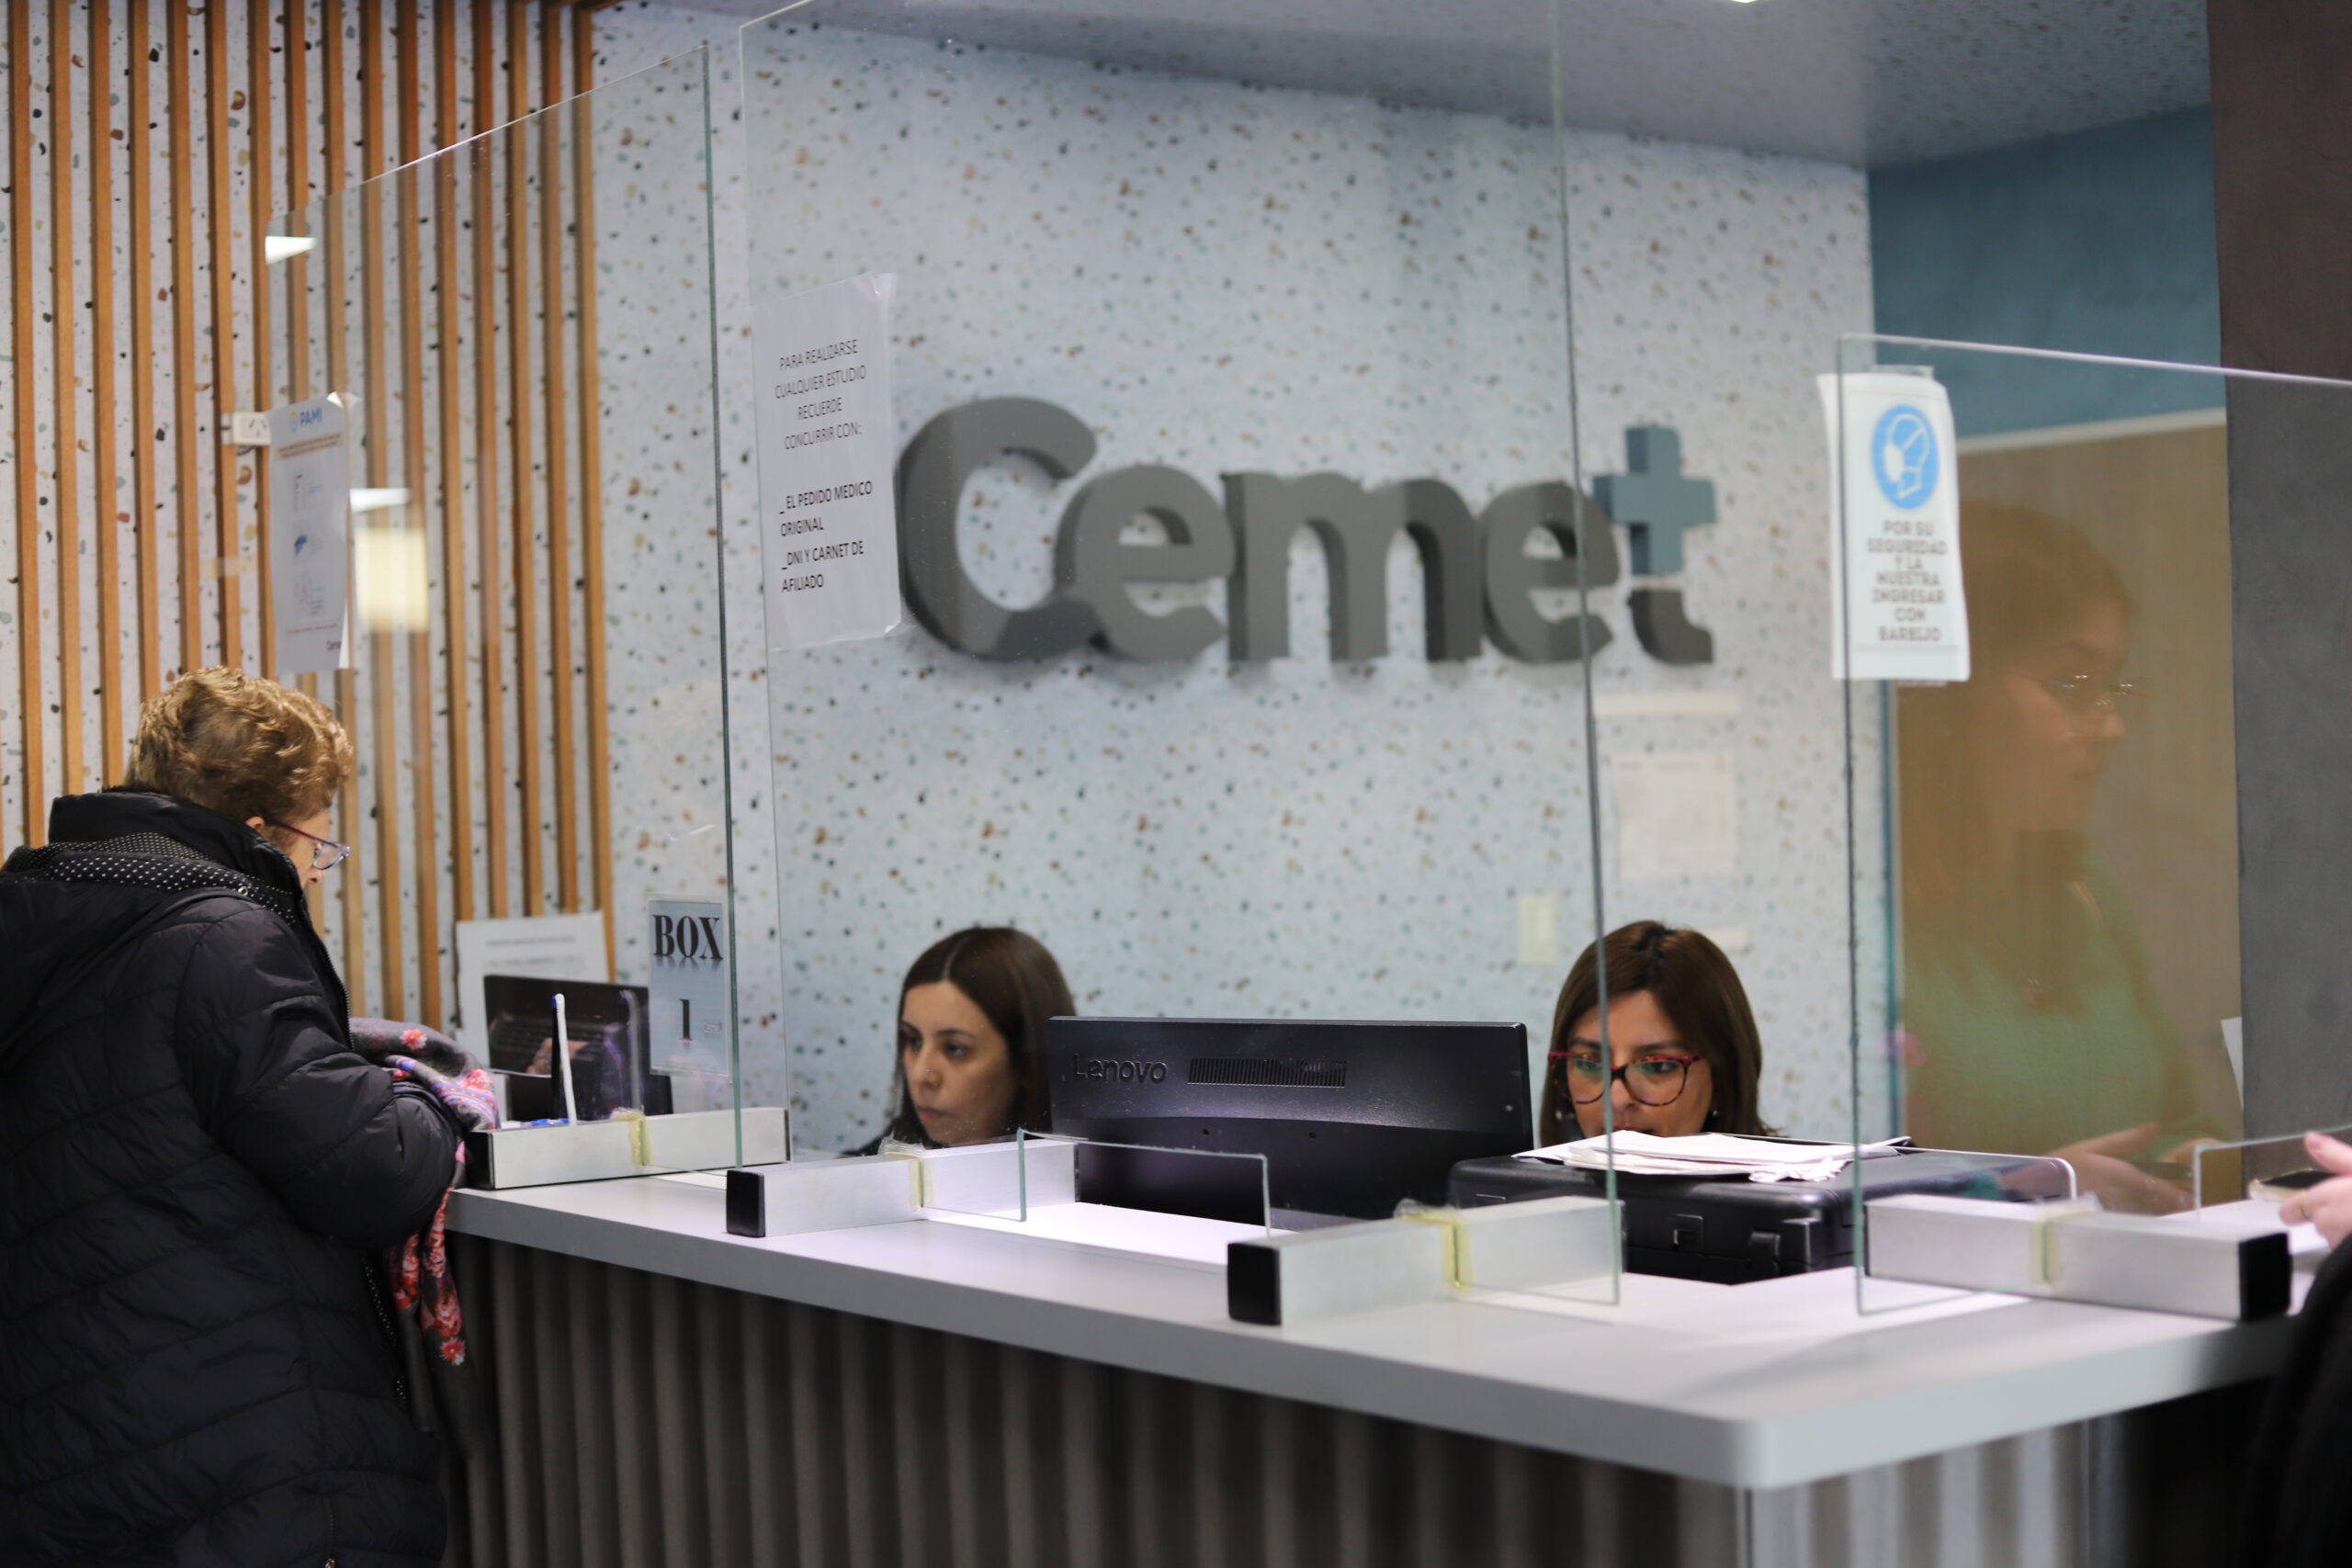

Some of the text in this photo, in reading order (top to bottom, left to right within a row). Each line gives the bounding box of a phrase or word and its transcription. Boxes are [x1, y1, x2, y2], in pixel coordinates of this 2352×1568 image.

[779, 339, 858, 371] PARA REALIZARSE
[775, 365, 866, 399] CUALQUIER ESTUDIO
[300, 407, 323, 426] PAMI
[797, 397, 842, 420] RECUERDE
[785, 422, 862, 450] CONCURRIR CON:
[798, 488, 832, 507] PEDIDO
[834, 480, 873, 501] MEDICO
[780, 517, 824, 536] ORIGINAL
[895, 396, 1717, 664] Cemet
[1883, 520, 1934, 536] POR SU
[805, 548, 811, 563] Y
[812, 543, 850, 562] CARNET
[852, 540, 865, 556] DE
[1867, 537, 1948, 555] SEGURIDAD
[1895, 556, 1923, 570] Y LA
[782, 573, 824, 592] AFILIADO
[1876, 571, 1940, 586] NUESTRA
[1872, 588, 1945, 604] INGRESAR
[1894, 607, 1926, 622] CON
[652, 913, 724, 961] BOX
[1072, 1053, 1169, 1085] Lenovo
